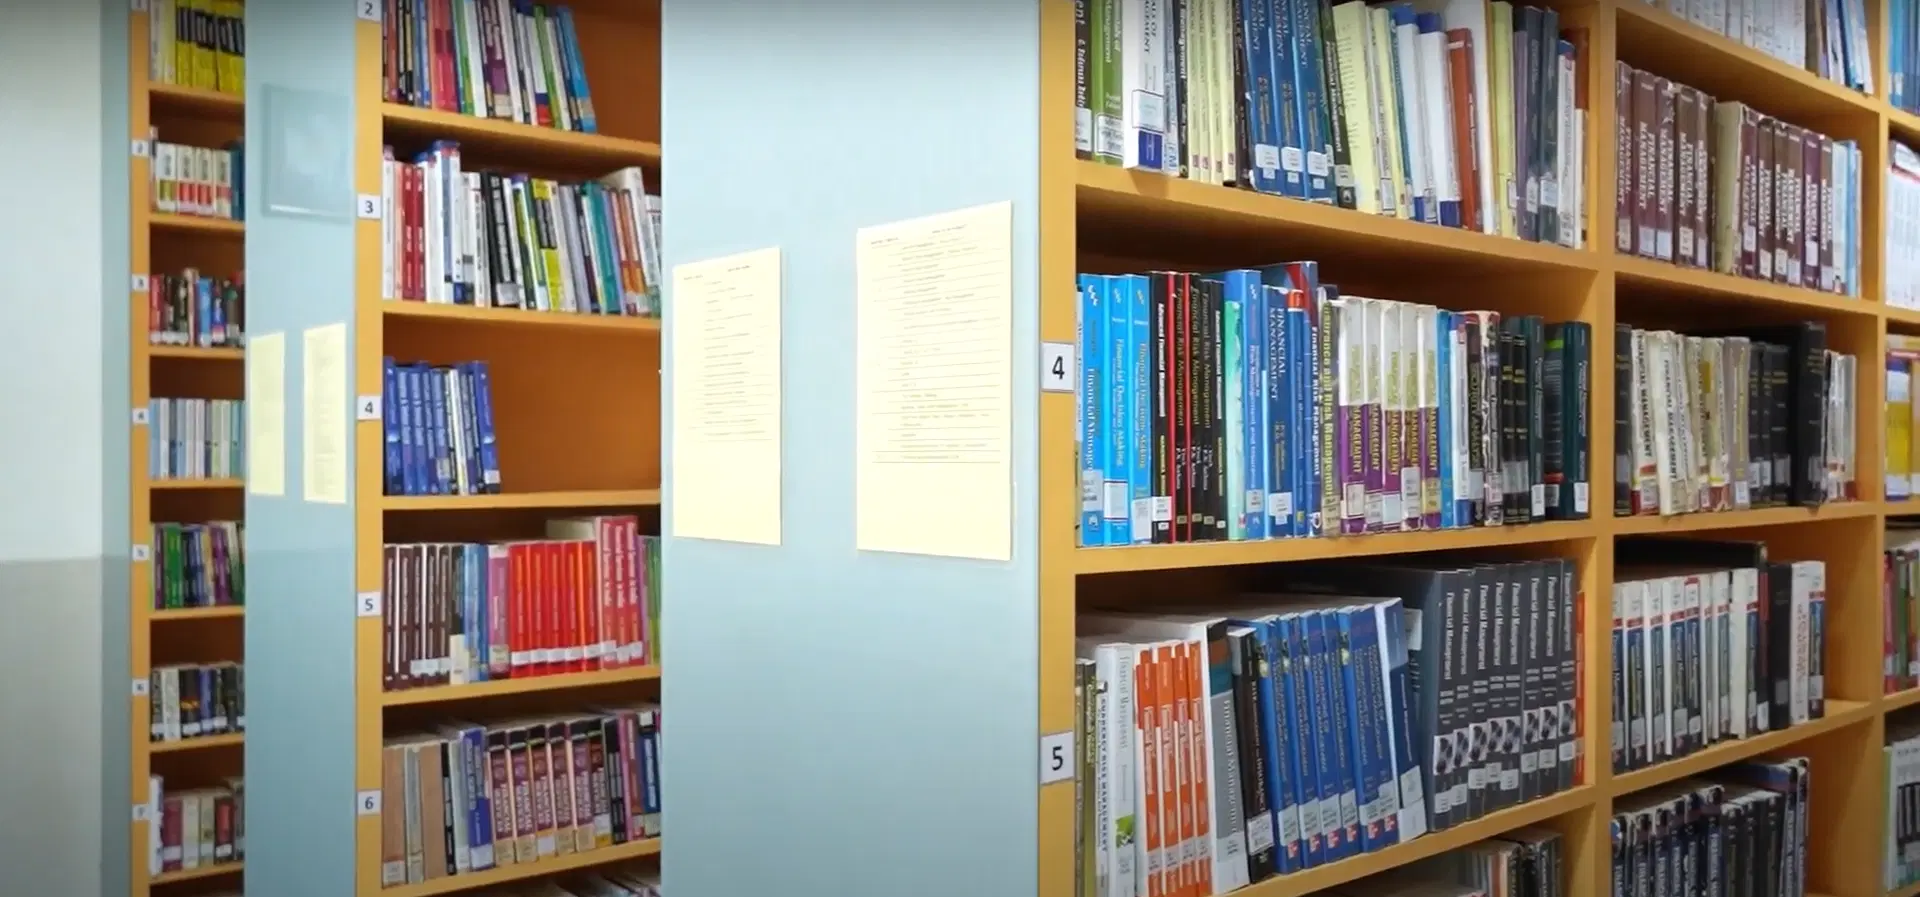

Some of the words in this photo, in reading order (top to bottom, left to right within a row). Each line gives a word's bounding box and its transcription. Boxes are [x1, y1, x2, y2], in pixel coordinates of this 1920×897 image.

[365, 2, 373, 15] 2
[1618, 115, 1626, 205] MANAGEMENT
[1625, 126, 1633, 194] FINANCIAL
[1639, 121, 1649, 210] MANAGEMENT
[1648, 133, 1657, 199] FINANCIAL
[1659, 128, 1668, 214] MANAGEMENT
[1667, 139, 1675, 204] FINANCIAL
[1679, 131, 1688, 217] MANAGEMENT
[1687, 143, 1695, 208] FINANCIAL
[365, 200, 374, 214] 3
[1190, 287, 1201, 334] Financial
[1202, 292, 1211, 338] Financial
[1177, 336, 1185, 355] Risk
[1192, 337, 1200, 356] Risk
[1269, 308, 1279, 402] MANAGEMENT
[1277, 308, 1286, 377] FINANCIAL
[1311, 327, 1319, 375] Financial
[1052, 356, 1065, 380] 4
[1192, 359, 1201, 425] Management
[1322, 368, 1333, 391] and
[365, 402, 374, 415] 4
[1086, 368, 1097, 420] Financial
[1176, 360, 1185, 427] Management
[1203, 363, 1212, 429] Management
[1322, 394, 1334, 420] Risk
[1311, 406, 1321, 476] Management
[1352, 406, 1362, 473] MANAGEMENT
[1372, 405, 1380, 471] MANAGEMENT
[1390, 411, 1400, 476] MANAGEMENT
[1428, 408, 1437, 471] MANAGEMENT
[1640, 388, 1654, 459] MANAGEMENT
[1668, 411, 1678, 480] MANAGEMENT
[365, 599, 374, 611] 5
[1446, 592, 1456, 628] Financial
[1462, 588, 1471, 624] Financial
[1479, 585, 1489, 620] Financial
[1494, 582, 1504, 617] Financial
[1510, 582, 1521, 617] Financial
[1531, 578, 1541, 612] Financial
[1547, 576, 1557, 609] Financial
[1564, 572, 1573, 605] Financial
[1459, 625, 1470, 675] Management
[1477, 621, 1489, 670] Management
[1492, 618, 1504, 666] Management
[1509, 618, 1521, 665] Management
[1529, 612, 1540, 659] Management
[1545, 610, 1556, 657] Management
[1564, 606, 1572, 652] Management
[1119, 656, 1131, 695] Financial
[1443, 629, 1454, 680] Management
[1118, 696, 1130, 749] Management
[1222, 700, 1236, 756] Financial
[1052, 745, 1064, 771] 5
[365, 796, 374, 810] 6
[1101, 782, 1109, 853] MANAGEMENT
